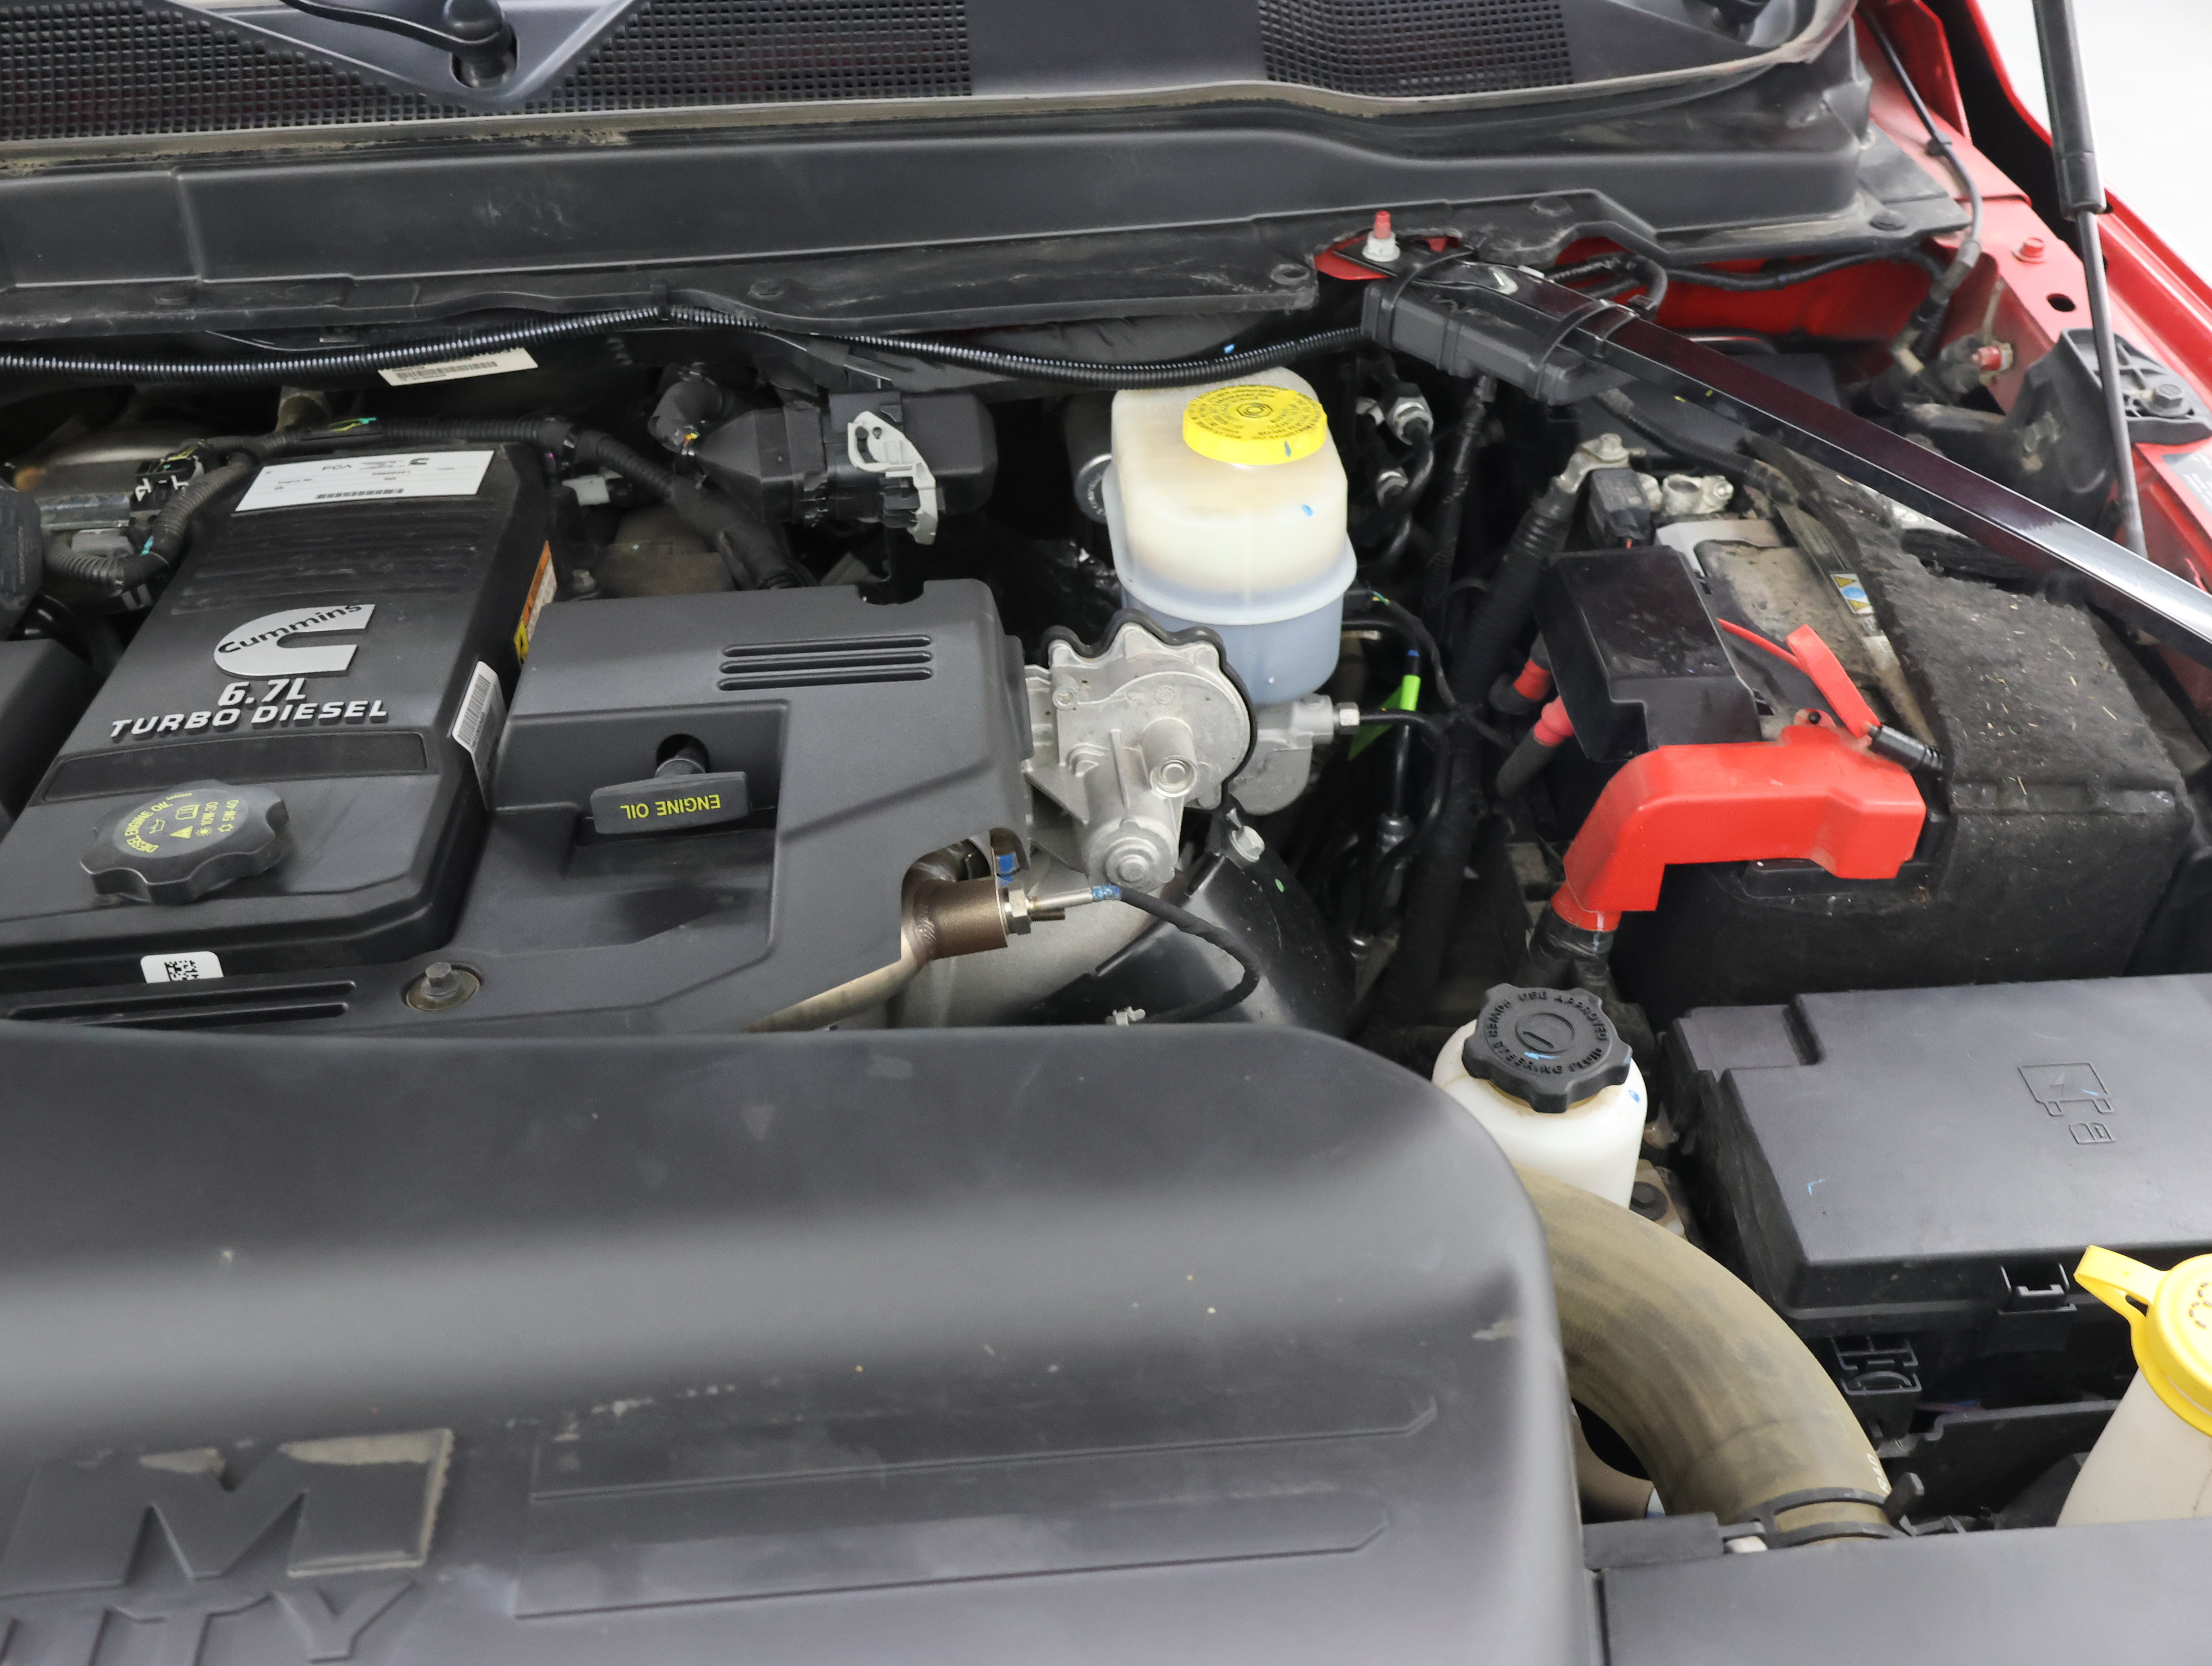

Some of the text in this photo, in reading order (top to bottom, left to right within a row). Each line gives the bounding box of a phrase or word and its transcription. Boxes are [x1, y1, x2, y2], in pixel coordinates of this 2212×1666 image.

[218, 604, 362, 653] Cummins
[218, 678, 306, 707] 6.7L
[110, 700, 387, 738] TURBO DIESEL
[124, 810, 155, 837] ENGINE
[150, 801, 174, 812] OIL
[200, 801, 219, 826] 10W-30
[222, 799, 240, 822] 5W-40
[620, 794, 721, 820] ENGINE OIL
